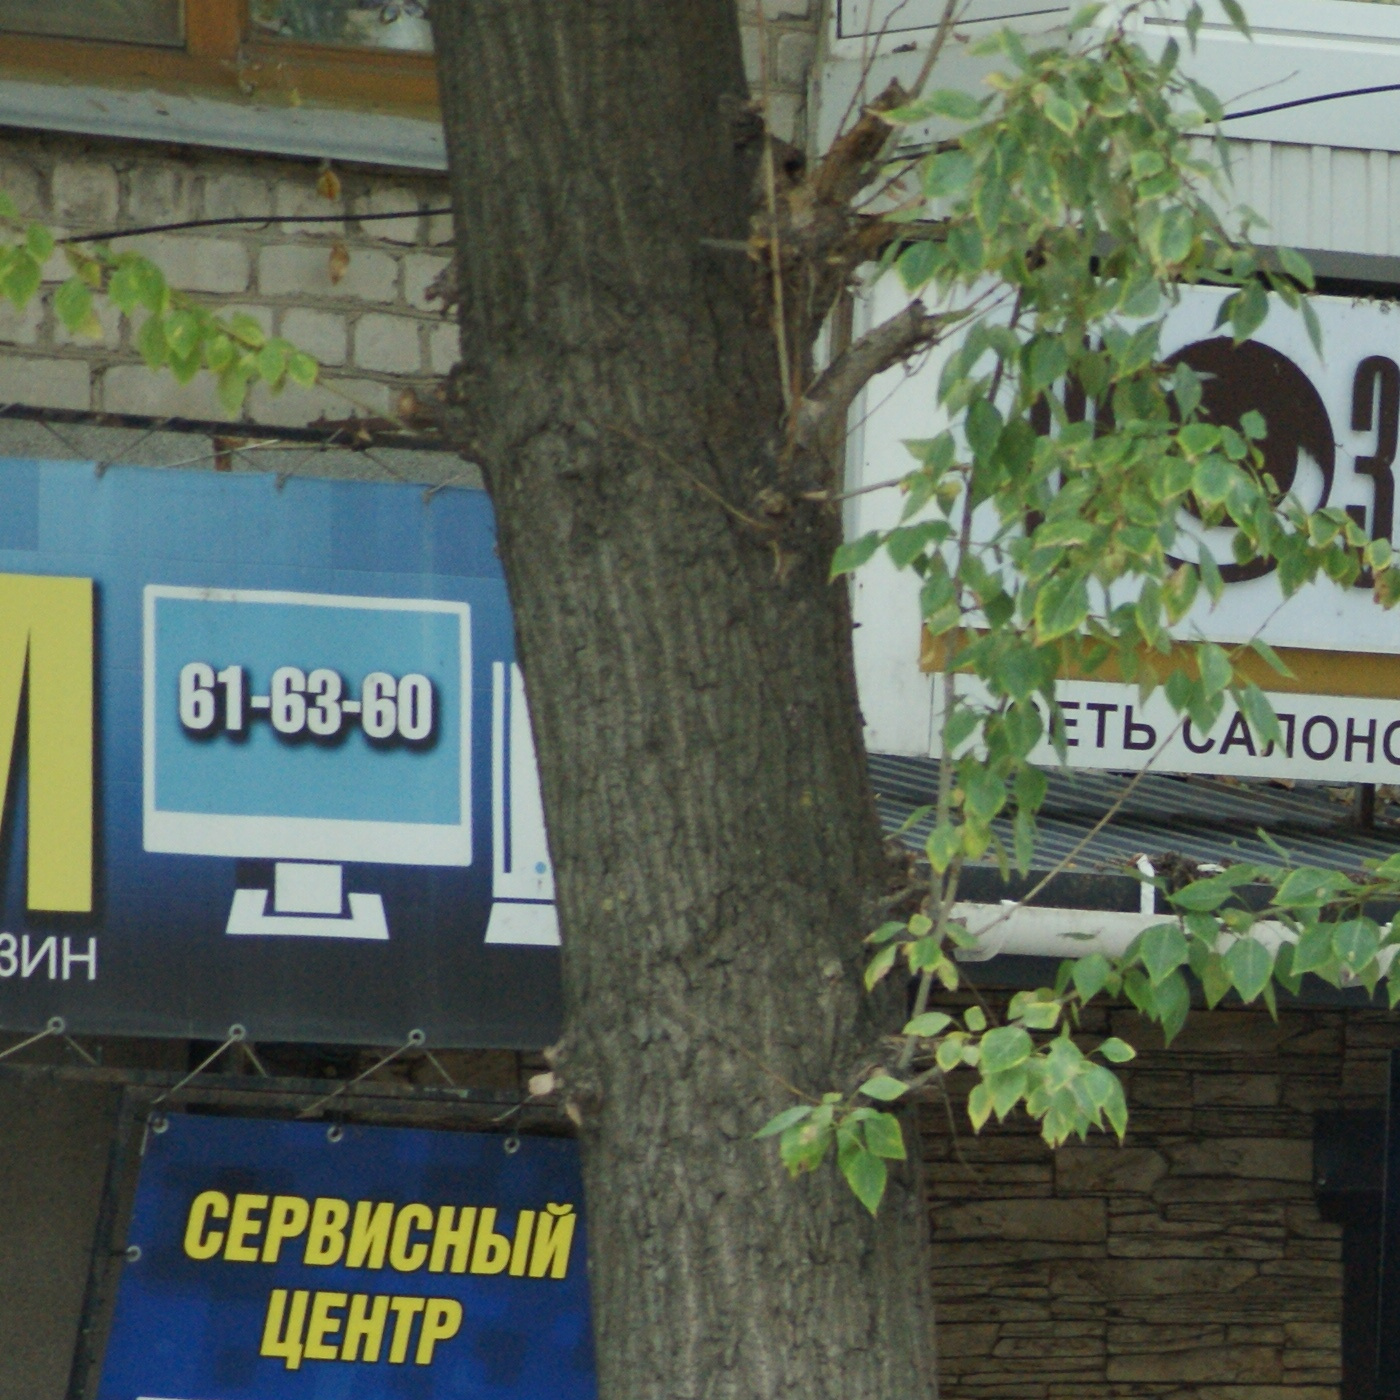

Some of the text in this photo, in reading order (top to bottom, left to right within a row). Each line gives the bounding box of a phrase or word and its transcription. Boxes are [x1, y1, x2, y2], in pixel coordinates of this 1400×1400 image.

[181, 662, 432, 740] 61-63-60
[1006, 698, 1157, 751] ЕТЬ
[183, 1190, 577, 1279] СЕРВИСНЫЙ
[260, 1289, 463, 1370] ЦЕНТР
